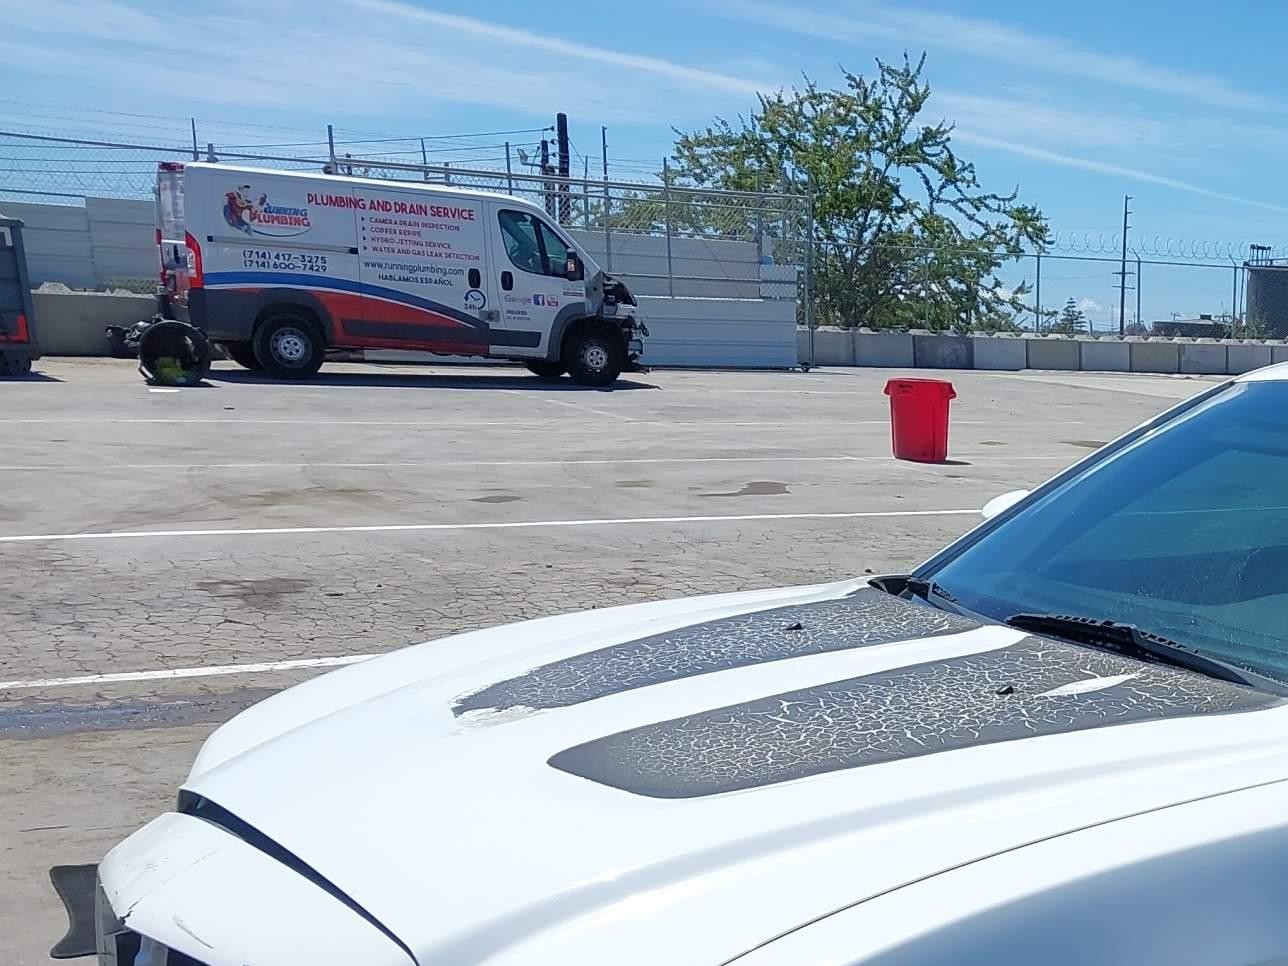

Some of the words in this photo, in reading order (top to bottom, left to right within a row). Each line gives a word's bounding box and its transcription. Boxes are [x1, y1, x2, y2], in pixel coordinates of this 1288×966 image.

[307, 192, 366, 210] PLUMBING
[369, 199, 392, 212] AND
[394, 202, 428, 216] DRAIN
[430, 206, 475, 221] SERVICE
[249, 209, 311, 227] PLUMBING
[369, 216, 398, 226] CAMERA
[400, 219, 420, 228] DRAIN
[421, 222, 460, 231] INSPECTION
[425, 241, 451, 249] SERVICE
[242, 249, 271, 260] (714)
[274, 253, 327, 265] 417-3275
[371, 245, 395, 255] WATER
[411, 249, 426, 257] GAS
[427, 250, 444, 259] LEAK
[445, 252, 480, 261] DETECTION
[244, 260, 271, 269] (714)
[273, 262, 327, 273] 600-7429
[363, 261, 465, 276] www.runningplumbing.com
[379, 273, 419, 284] HABLAMOS
[420, 276, 454, 287] ESPAÑOL
[464, 303, 477, 311] 24h
[504, 294, 532, 305] Google
